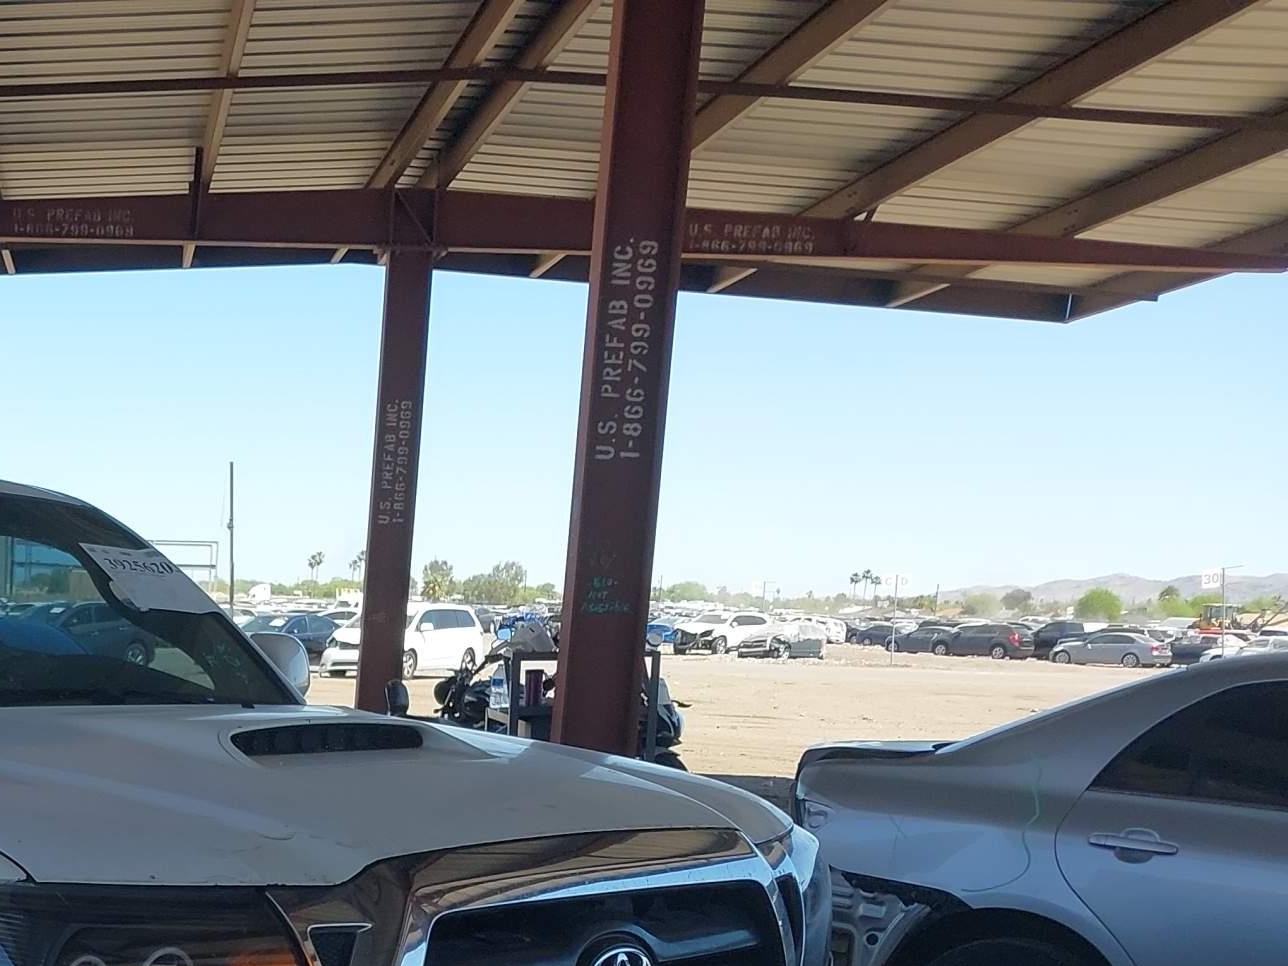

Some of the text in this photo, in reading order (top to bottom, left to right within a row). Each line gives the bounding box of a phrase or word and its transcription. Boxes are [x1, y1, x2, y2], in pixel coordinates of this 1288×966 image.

[724, 224, 781, 238] PREFAB
[594, 236, 636, 462] U.S. PREFAB INC.
[620, 240, 660, 460] 1-866-799-0969
[386, 399, 400, 426] INC.
[381, 433, 396, 489] PREFAB
[392, 400, 413, 523] 1-866-799-0969
[1203, 573, 1219, 584] 30
